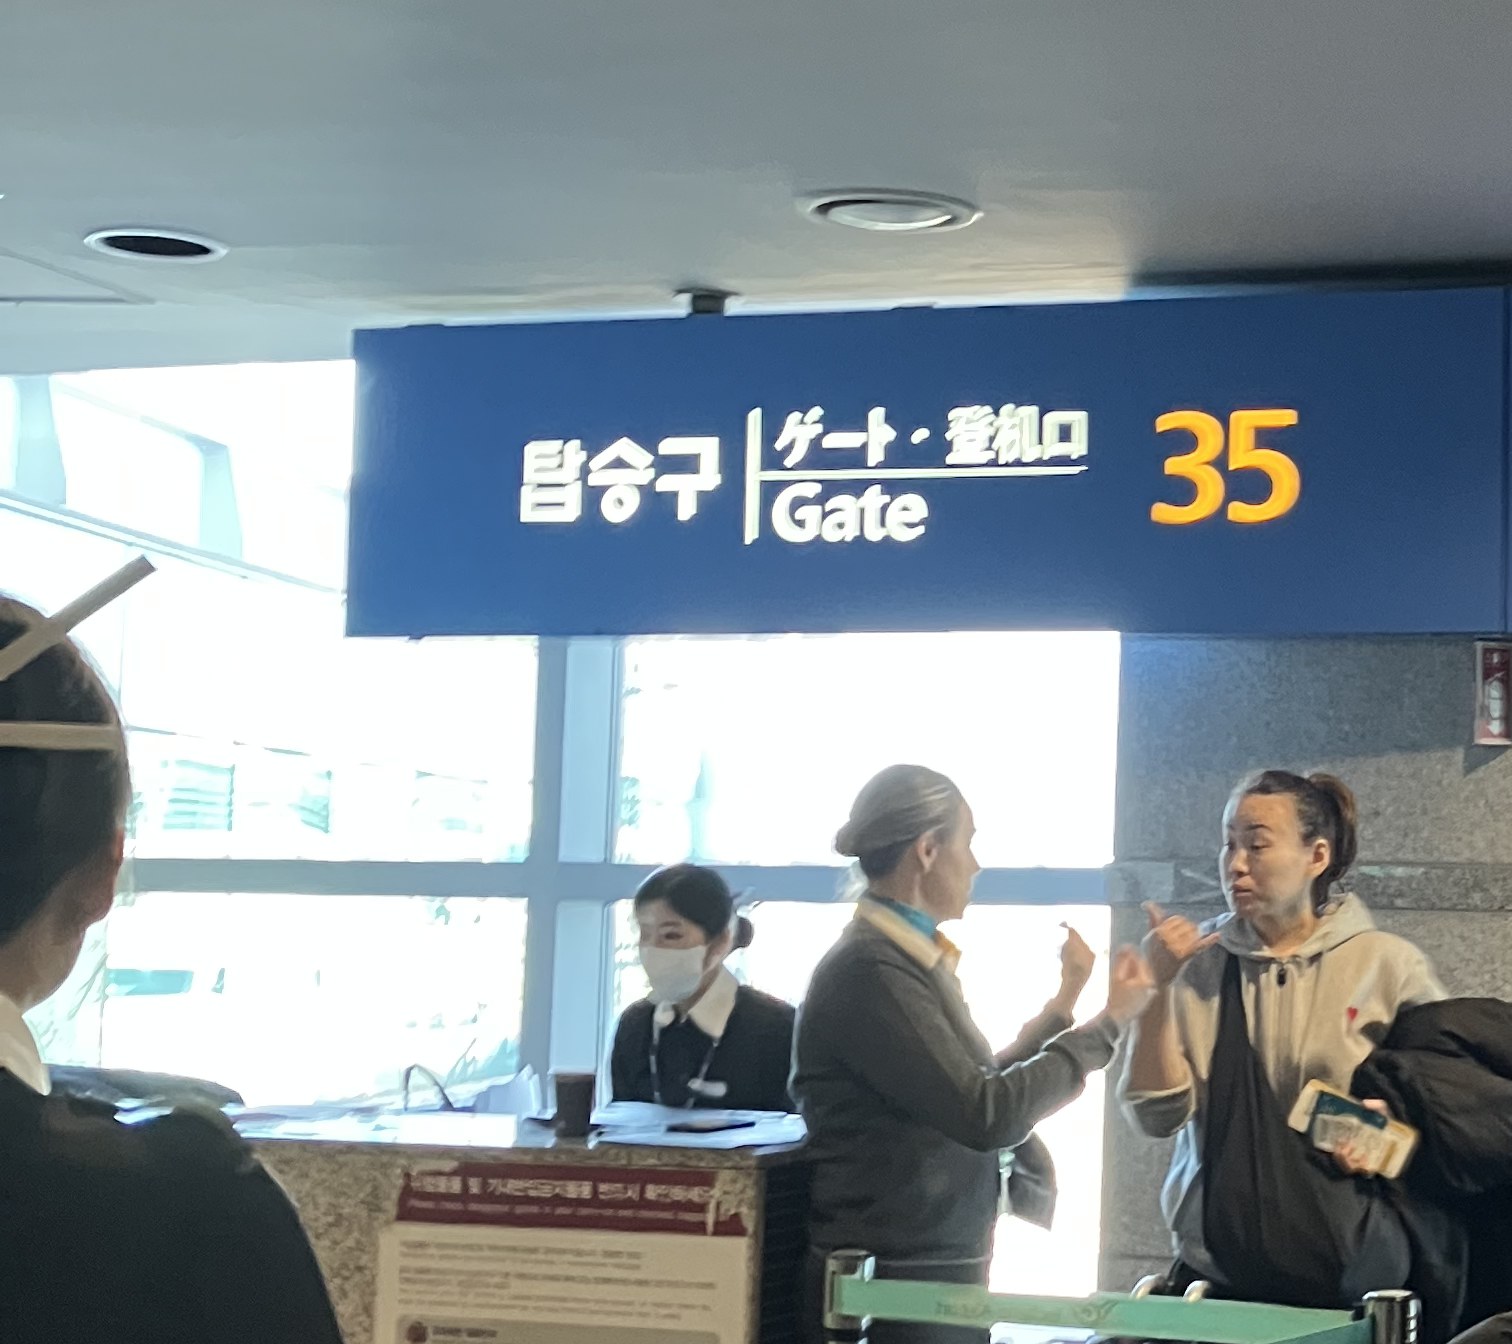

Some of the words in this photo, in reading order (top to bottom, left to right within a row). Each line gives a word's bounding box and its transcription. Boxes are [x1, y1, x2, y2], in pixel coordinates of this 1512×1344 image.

[519, 436, 722, 524] 탑승구
[1151, 408, 1301, 525] 35
[772, 481, 929, 543] Gate
